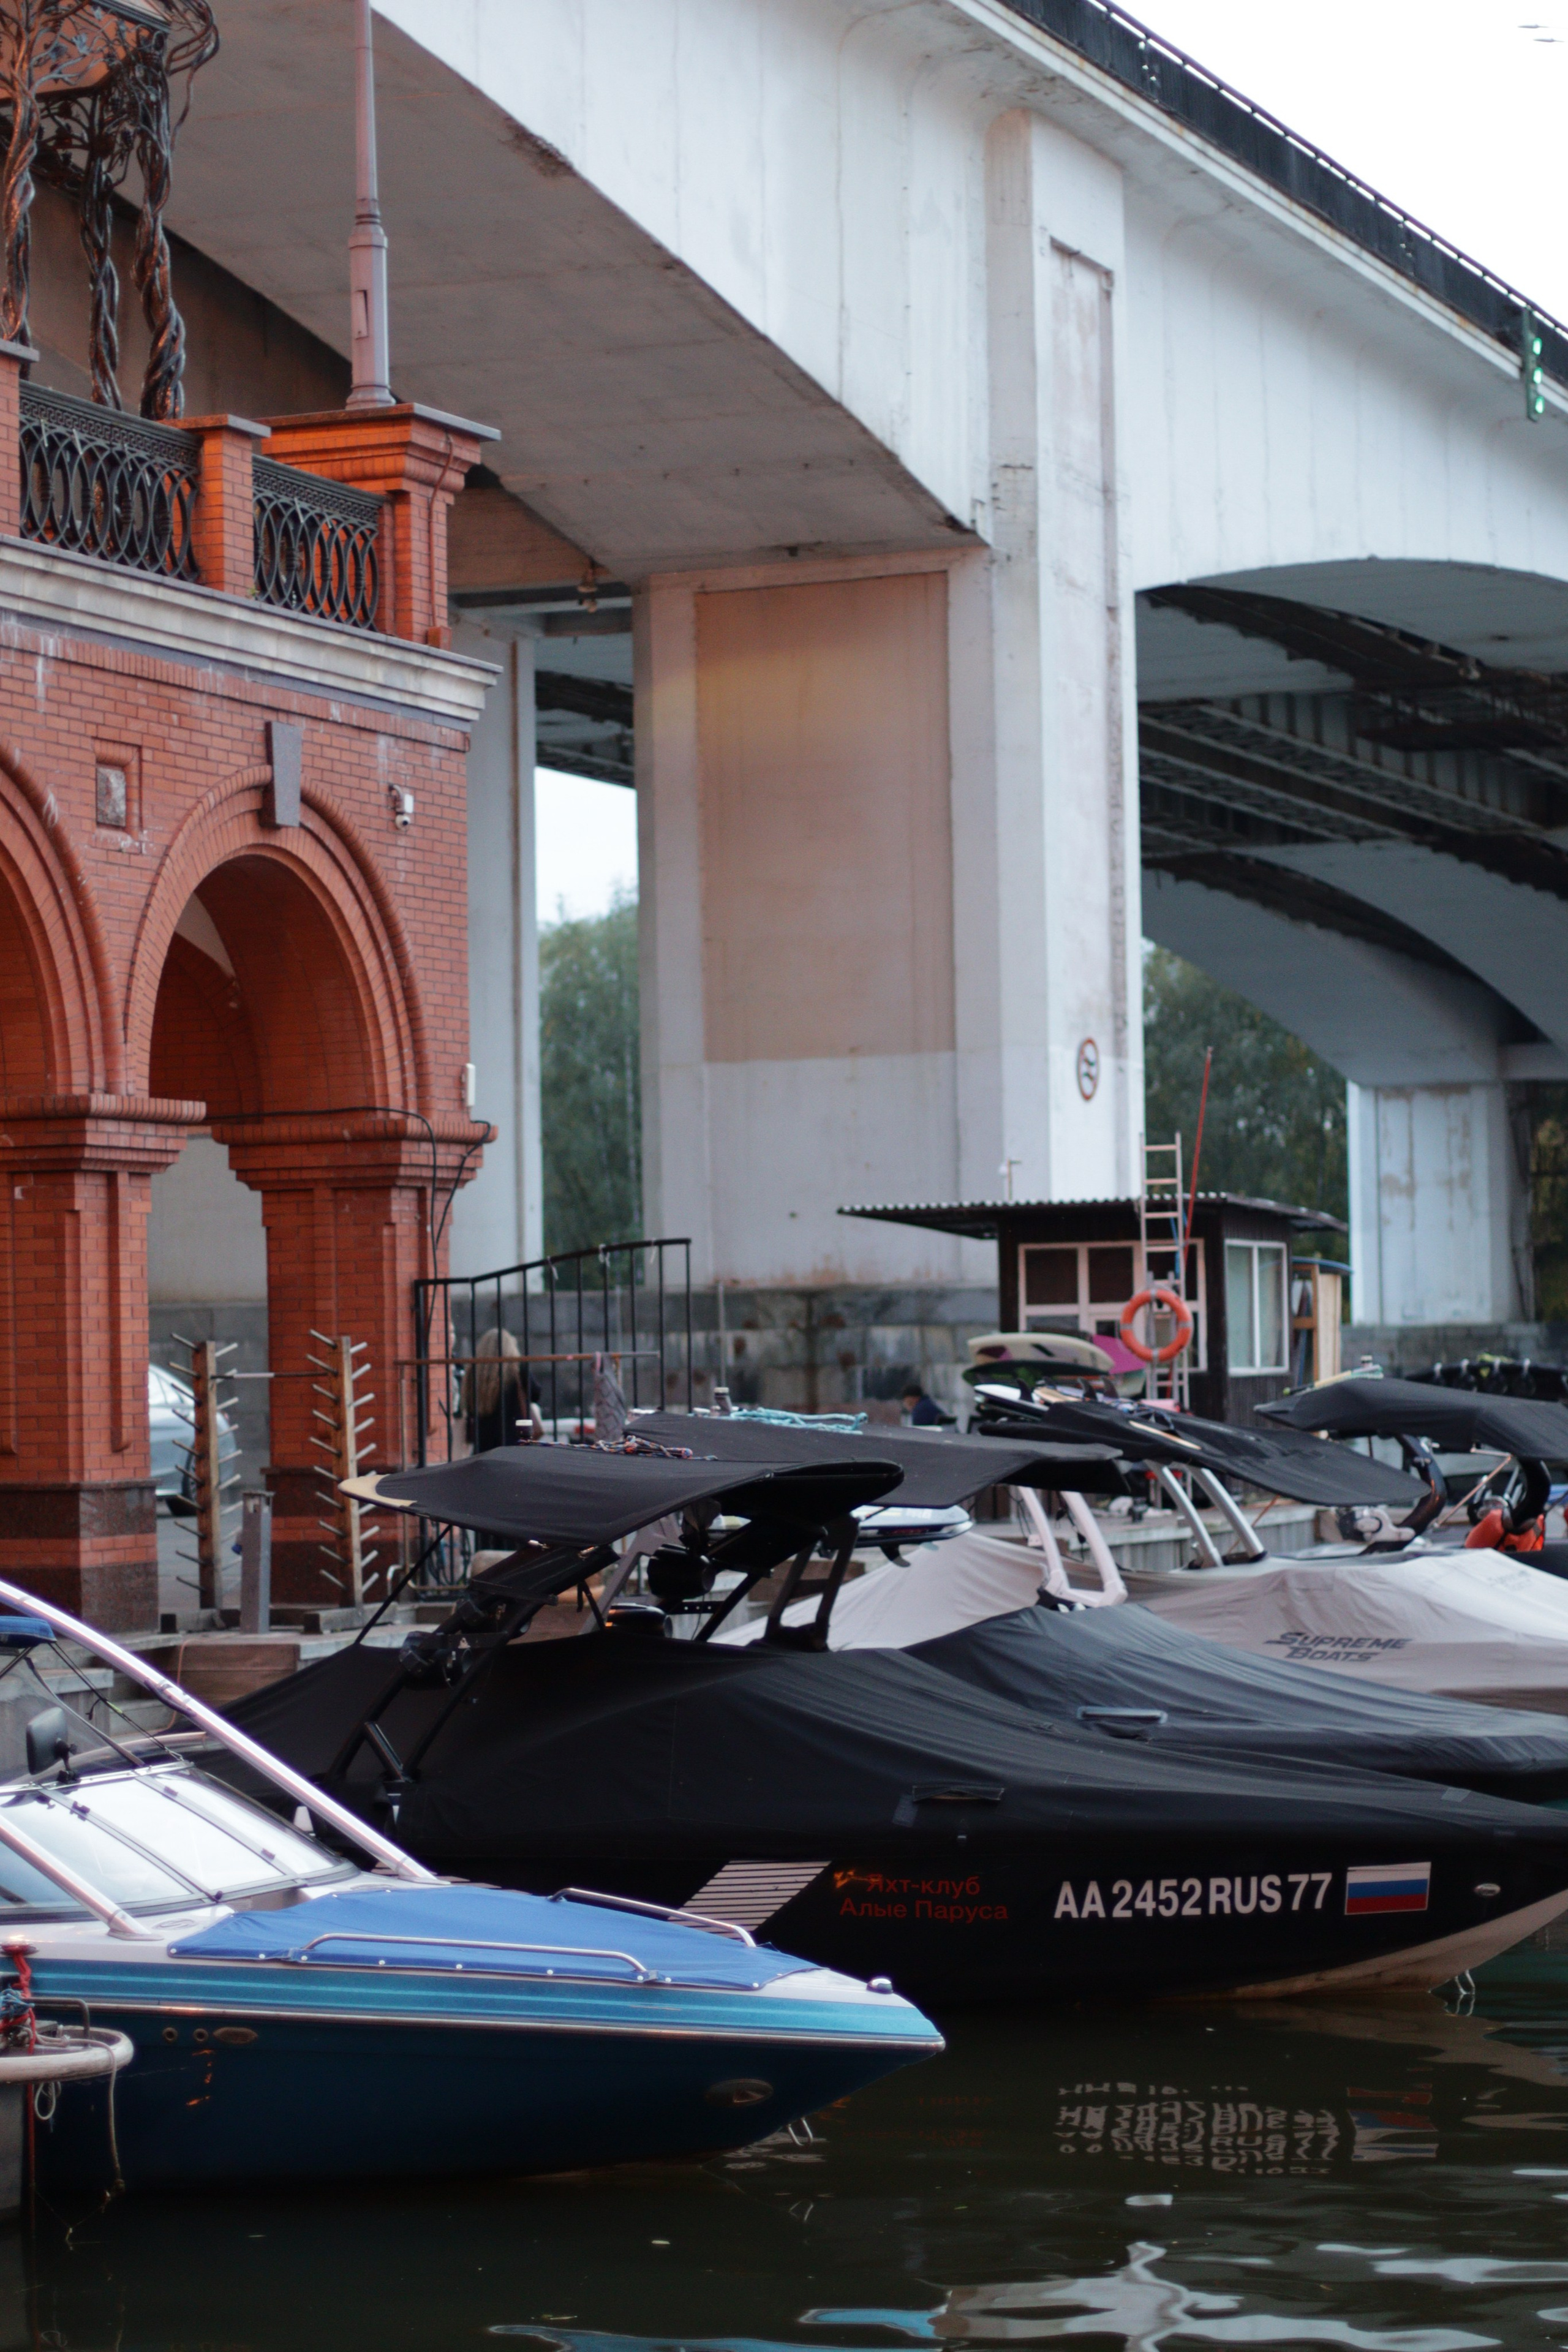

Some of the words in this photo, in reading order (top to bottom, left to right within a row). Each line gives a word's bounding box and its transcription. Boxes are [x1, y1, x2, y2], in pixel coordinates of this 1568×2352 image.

[1264, 1632, 1412, 1649] SUPREME
[1285, 1646, 1381, 1662] BOATS
[867, 1873, 979, 1899] Яхт-клуб
[839, 1898, 907, 1918] Алые
[915, 1900, 1009, 1923] Паруса
